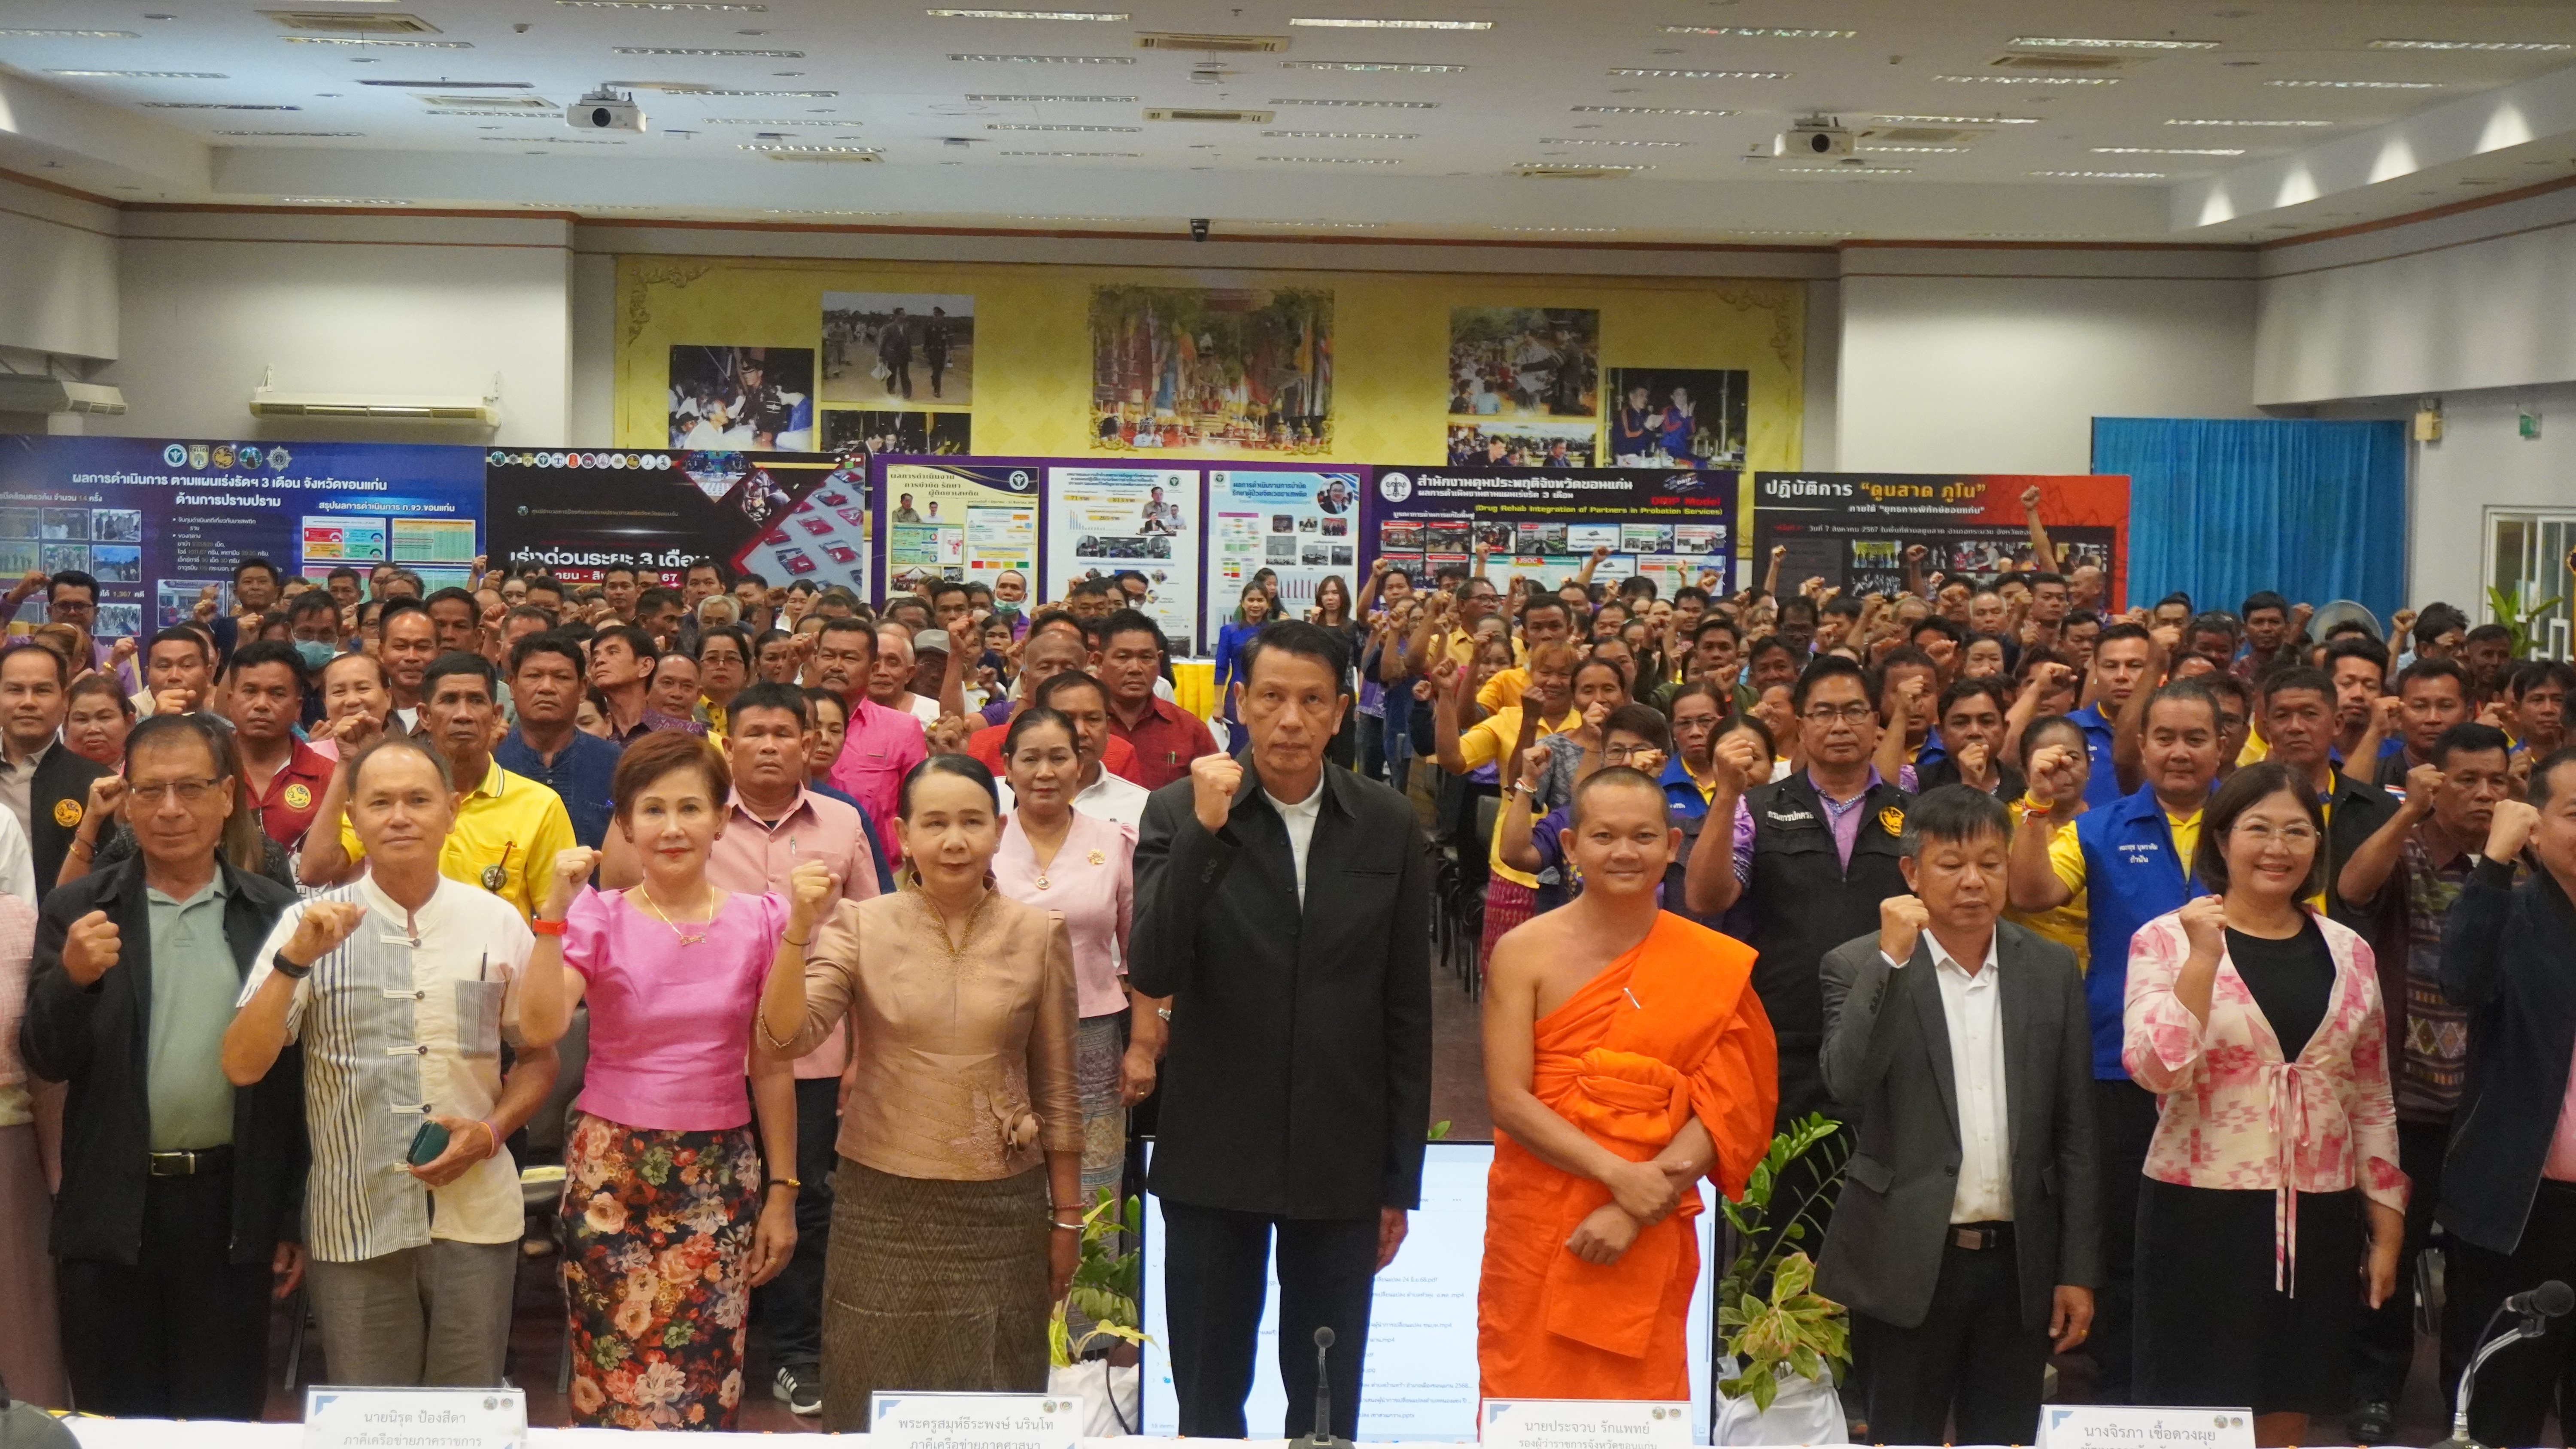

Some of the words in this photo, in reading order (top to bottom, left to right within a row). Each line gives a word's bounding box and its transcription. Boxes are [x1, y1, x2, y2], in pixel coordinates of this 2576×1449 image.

[73, 471, 168, 485] ผลการดำเนินการ
[171, 475, 259, 488] ตามแผนเร่งรัดฯ
[261, 478, 269, 488] 3
[272, 477, 301, 489] เดือน
[304, 477, 387, 491] จังหวัดขอนแก่น
[1417, 474, 1633, 490] สำนักงานคุมประพฤติจังหวัดขอนแก่น
[1552, 490, 1574, 499] เดือน
[1765, 479, 1853, 498] ปฏิบัติการ
[88, 492, 103, 502] ครั้ง
[176, 492, 281, 507] ด้านการปราบปราม
[319, 501, 400, 512] สรุปผลการดำเนินการ
[1528, 505, 1576, 514] Integration
[1848, 504, 1876, 513] ภายใต้
[365, 1410, 413, 1428] นายนิรุต
[418, 1410, 466, 1424] ป้องสีดา
[899, 1415, 1011, 1434] พระครูสมุห์ธีระพงษ์
[1525, 1420, 1596, 1433] นายประจวบ
[1600, 1420, 1650, 1434] รักแพทย์
[2084, 1423, 2143, 1438] นางจิรภา
[2149, 1420, 2216, 1446] เชื้อดวงผุย
[343, 1432, 482, 1447] ภาคีเครือข่ายภาคราชการ
[910, 1437, 1041, 1449] ภาคีเครือข่ายภาคศาสนา
[1519, 1437, 1657, 1449] รองผู้ว่าราชการจังหวัดขอนแก่น
